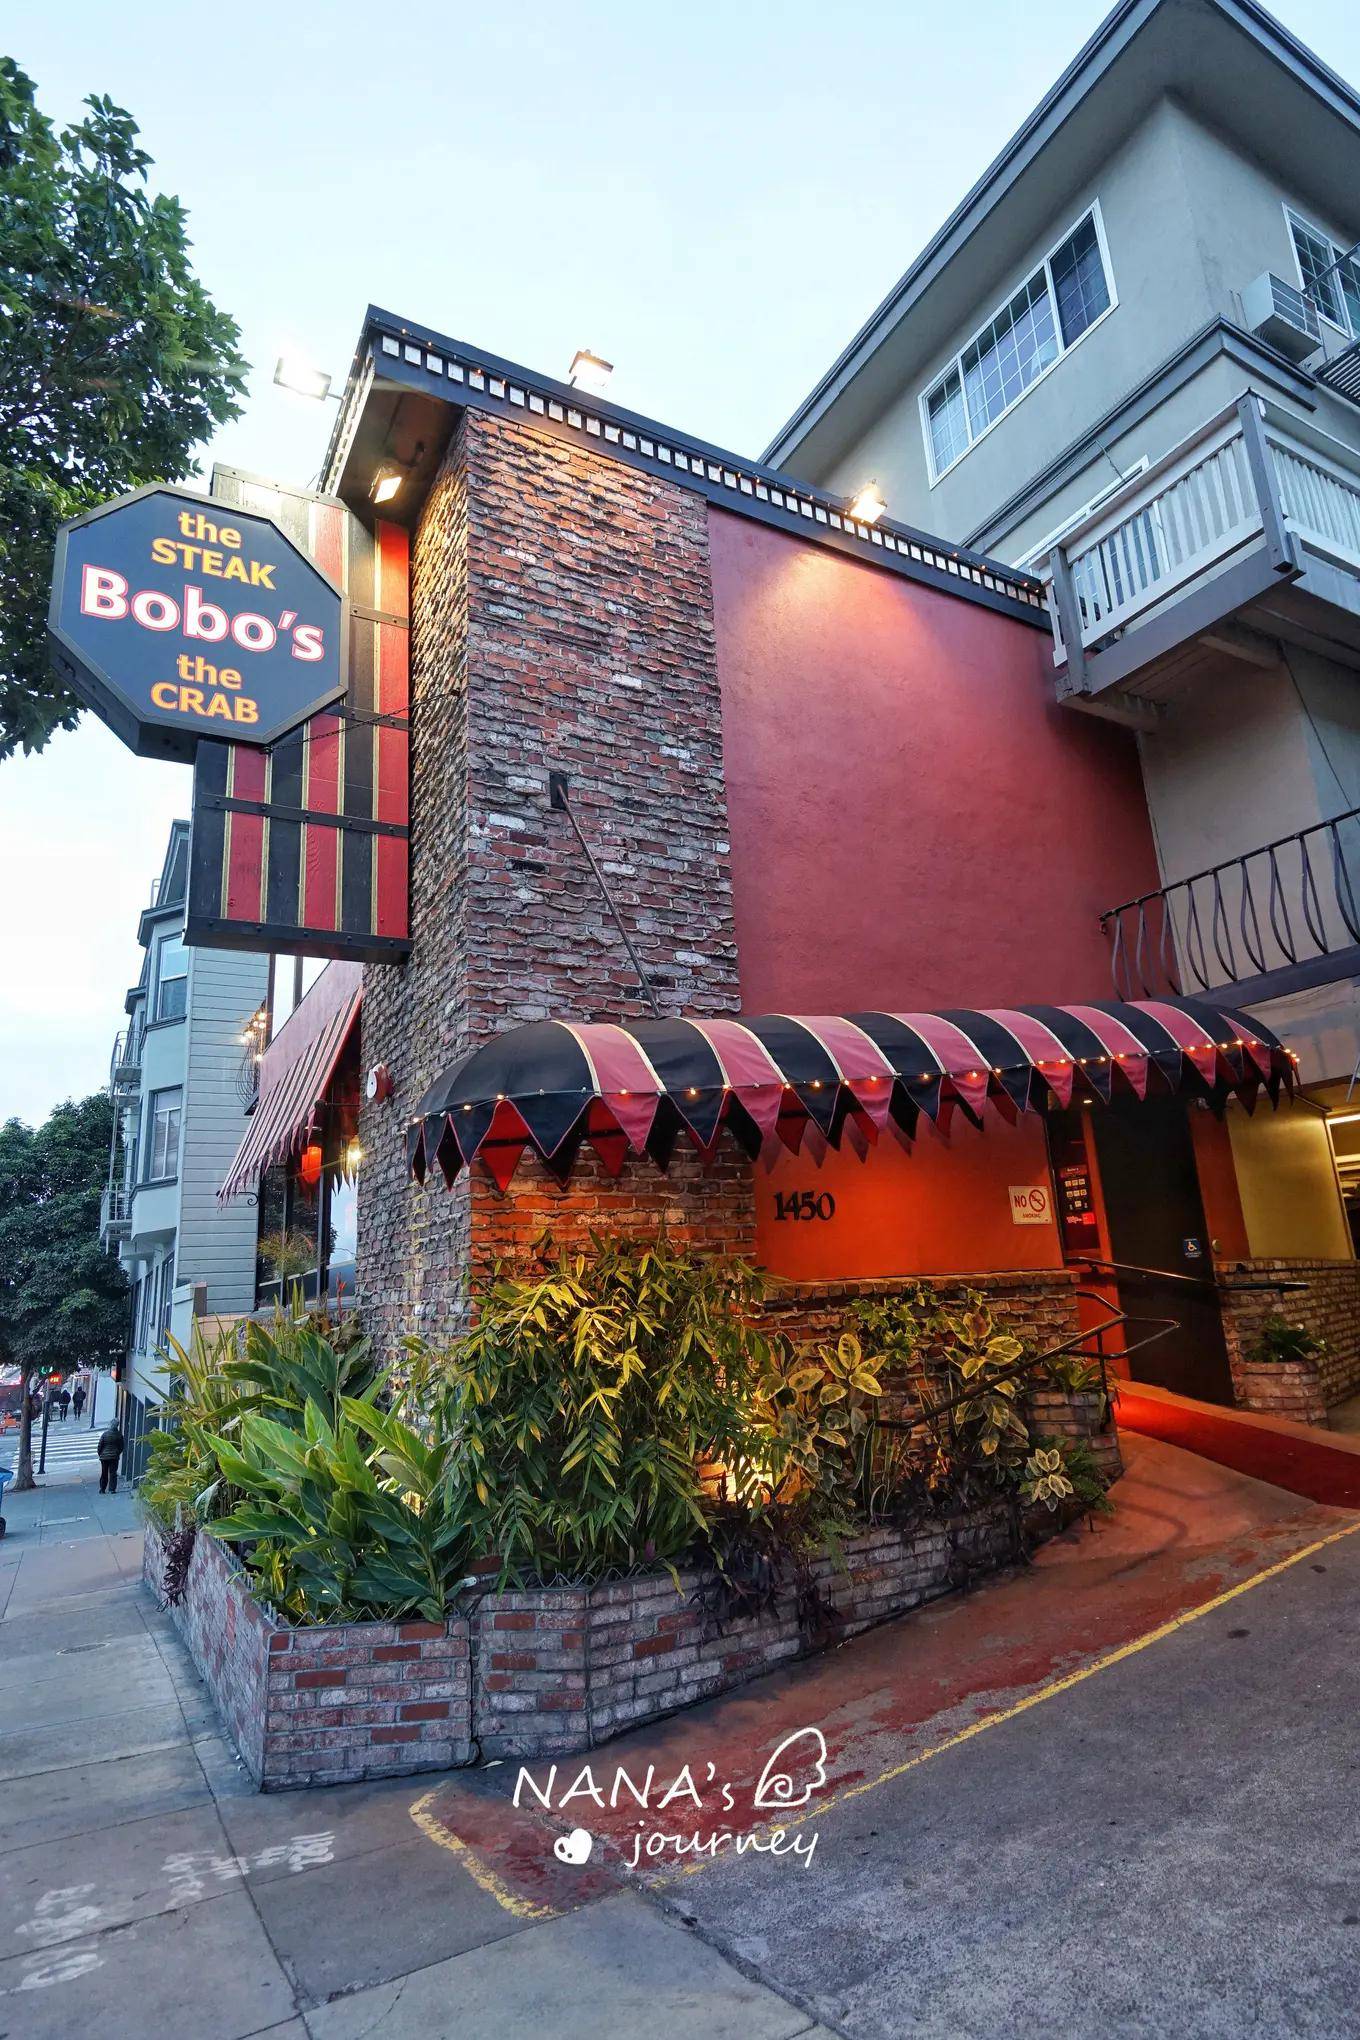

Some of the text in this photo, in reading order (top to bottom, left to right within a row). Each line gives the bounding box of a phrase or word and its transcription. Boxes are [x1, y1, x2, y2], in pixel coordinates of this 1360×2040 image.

[177, 511, 242, 549] the
[151, 537, 277, 590] STEAK
[80, 563, 325, 662] Bobo's
[177, 653, 242, 690] the
[150, 681, 260, 724] CRAB
[773, 1191, 835, 1220] 1450
[1014, 1195, 1027, 1207] NO
